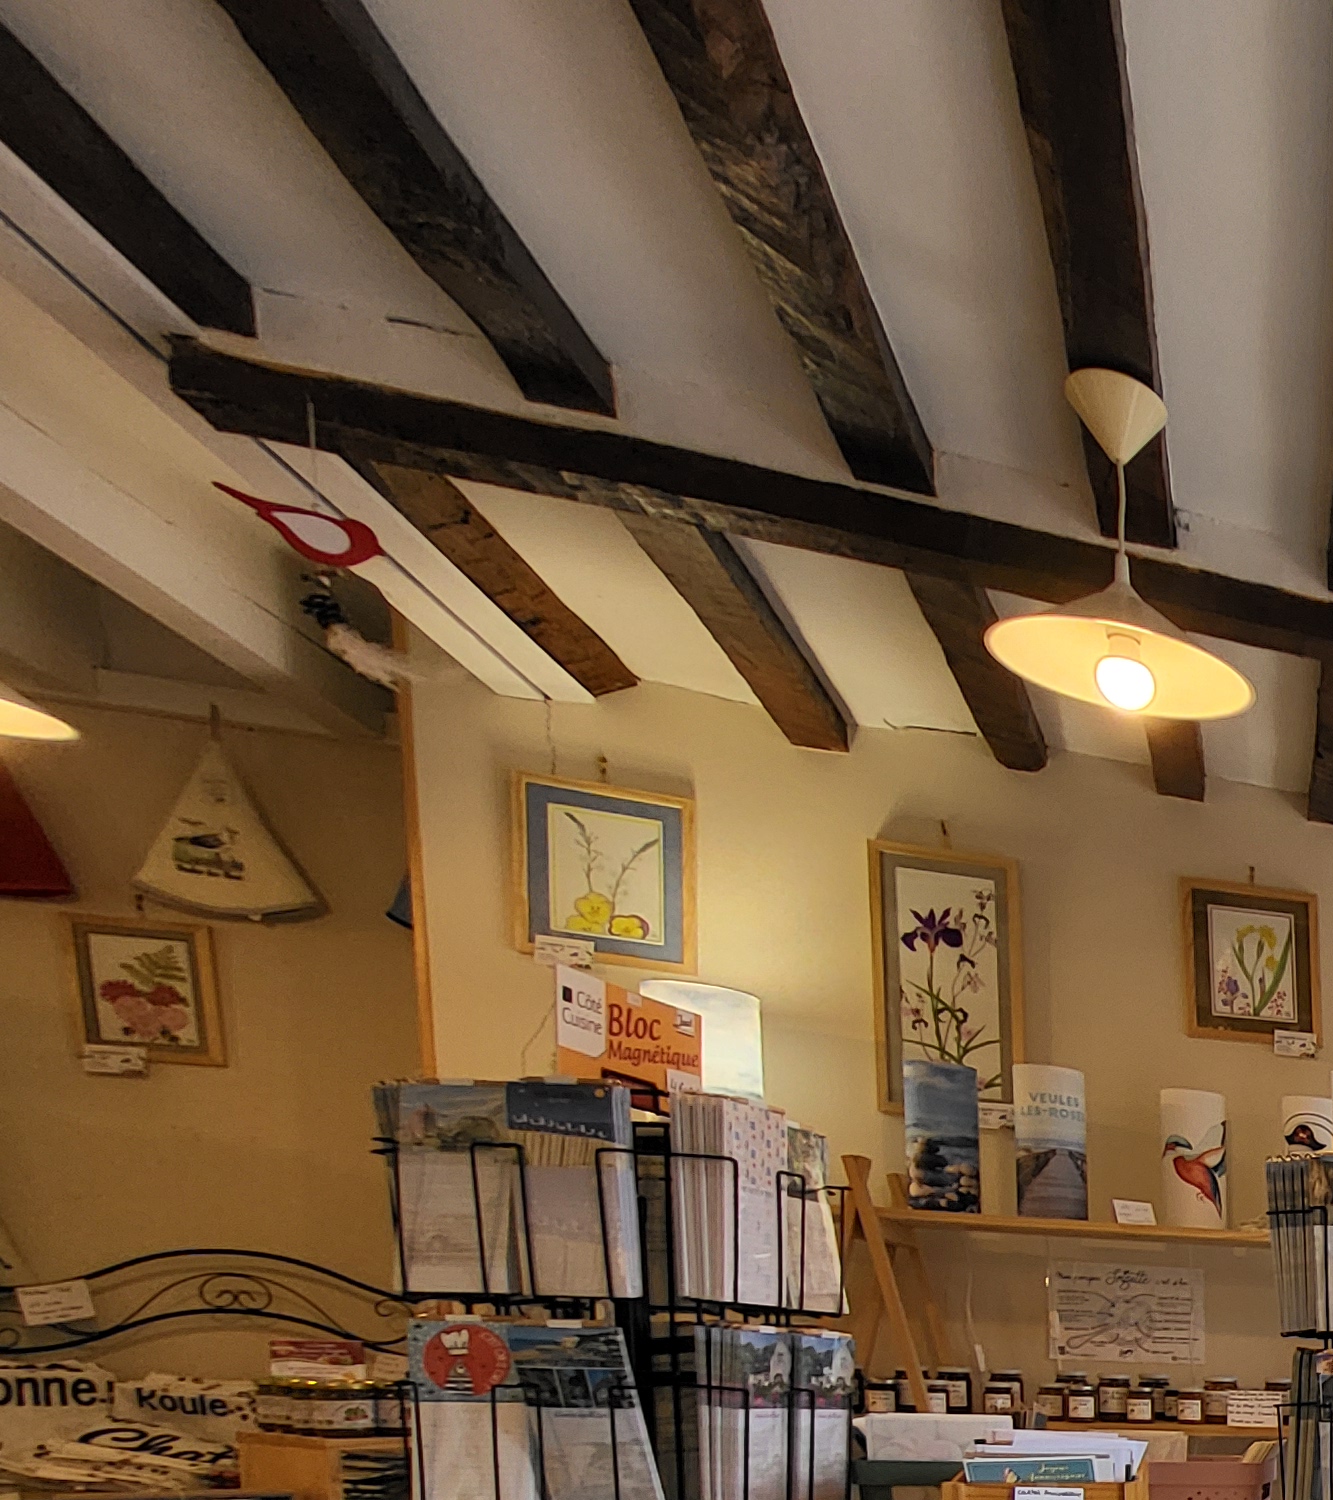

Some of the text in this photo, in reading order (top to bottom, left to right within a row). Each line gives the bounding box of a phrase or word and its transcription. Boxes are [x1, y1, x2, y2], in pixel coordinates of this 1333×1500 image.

[576, 990, 603, 1015] Côté
[561, 1007, 603, 1036] Cuisine
[608, 1003, 661, 1041] Bloc
[607, 1039, 699, 1069] Magnétique
[1029, 1091, 1080, 1108] VEULES
